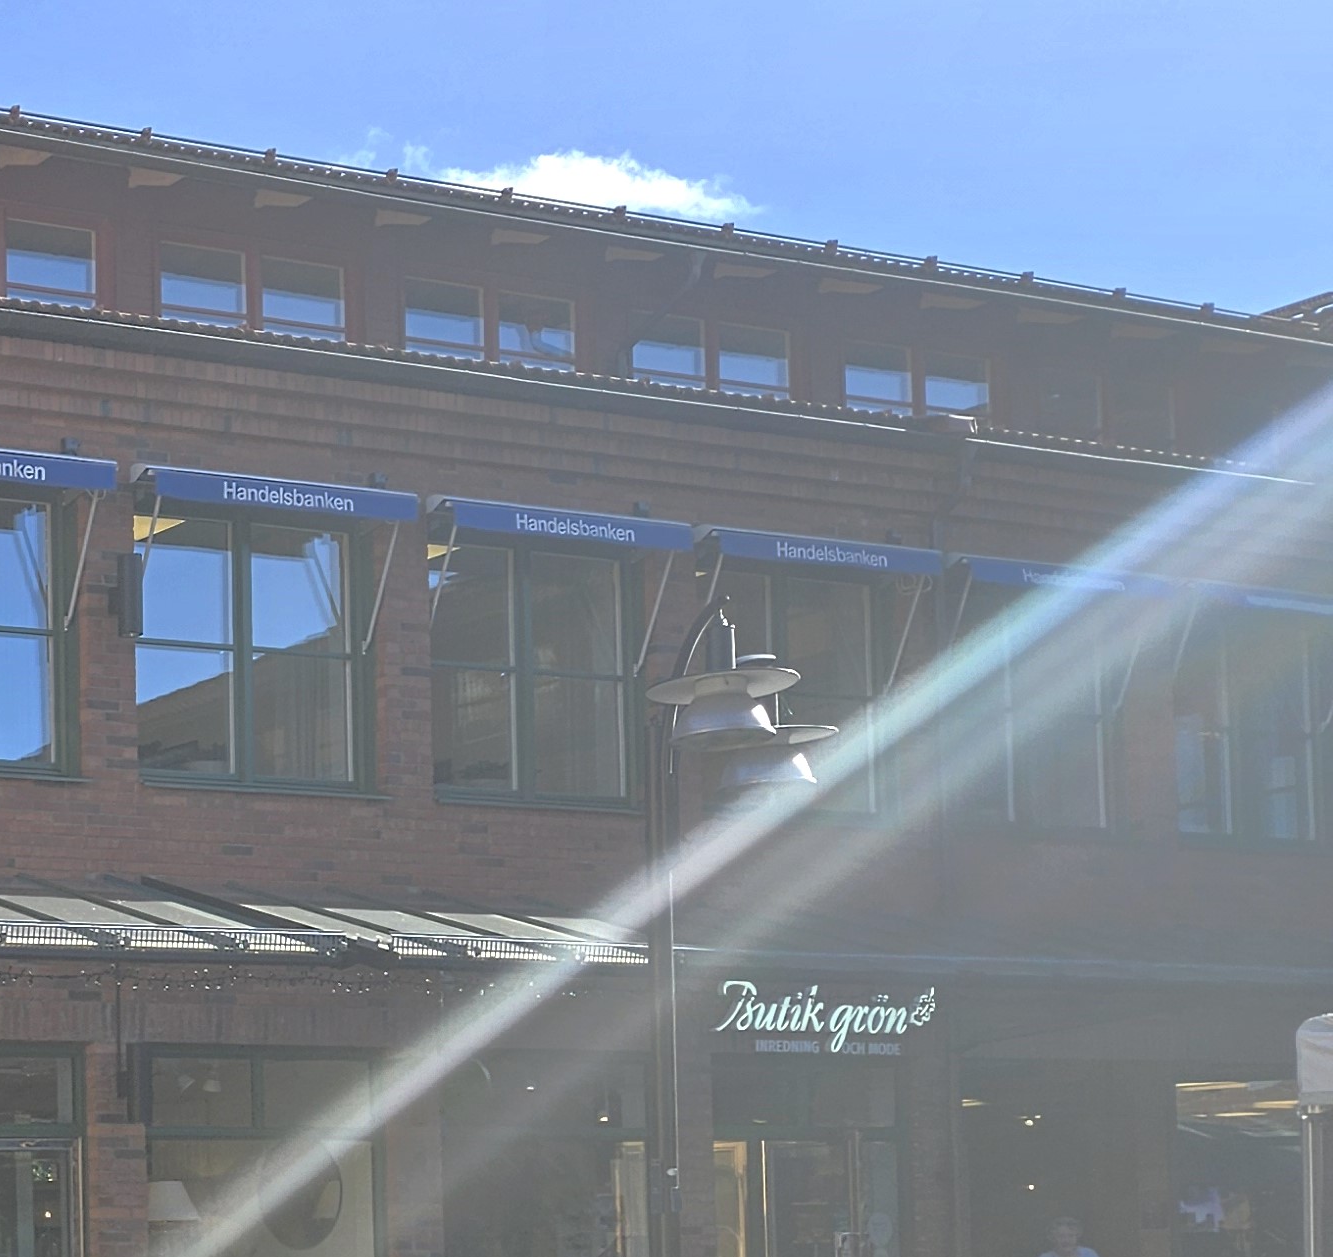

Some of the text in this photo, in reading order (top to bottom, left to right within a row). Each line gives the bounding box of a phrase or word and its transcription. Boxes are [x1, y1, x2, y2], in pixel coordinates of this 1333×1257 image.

[223, 481, 354, 512] Handelsbanken
[516, 513, 635, 542] Handelsbanken
[776, 541, 888, 567] Handelsbanken
[713, 980, 909, 1053] Butik grön
[755, 1039, 902, 1056] INREDNING OCH MODE
